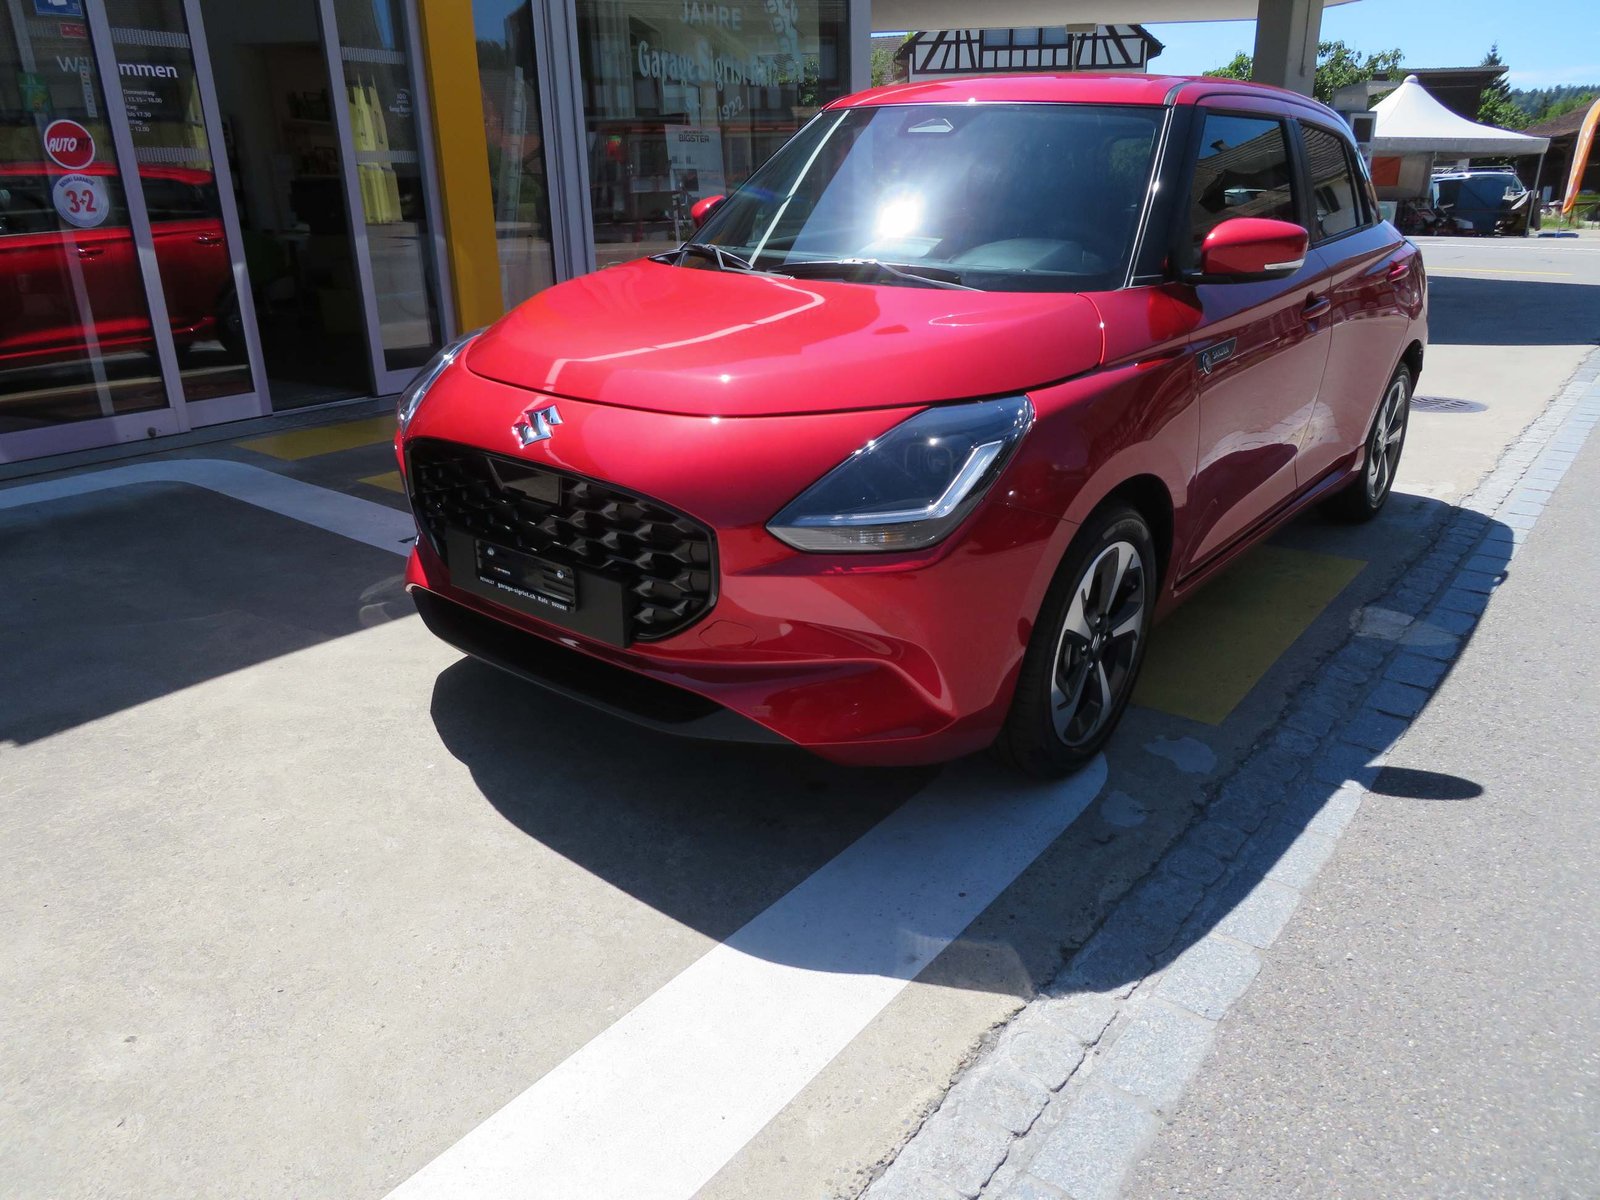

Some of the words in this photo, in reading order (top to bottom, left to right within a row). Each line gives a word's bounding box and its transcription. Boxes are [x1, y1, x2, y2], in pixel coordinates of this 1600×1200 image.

[681, 1, 743, 31] JAHRE
[638, 40, 695, 88] Garage
[718, 96, 744, 121] 1922
[679, 134, 710, 143] BIGSTER
[66, 189, 97, 213] 3+2
